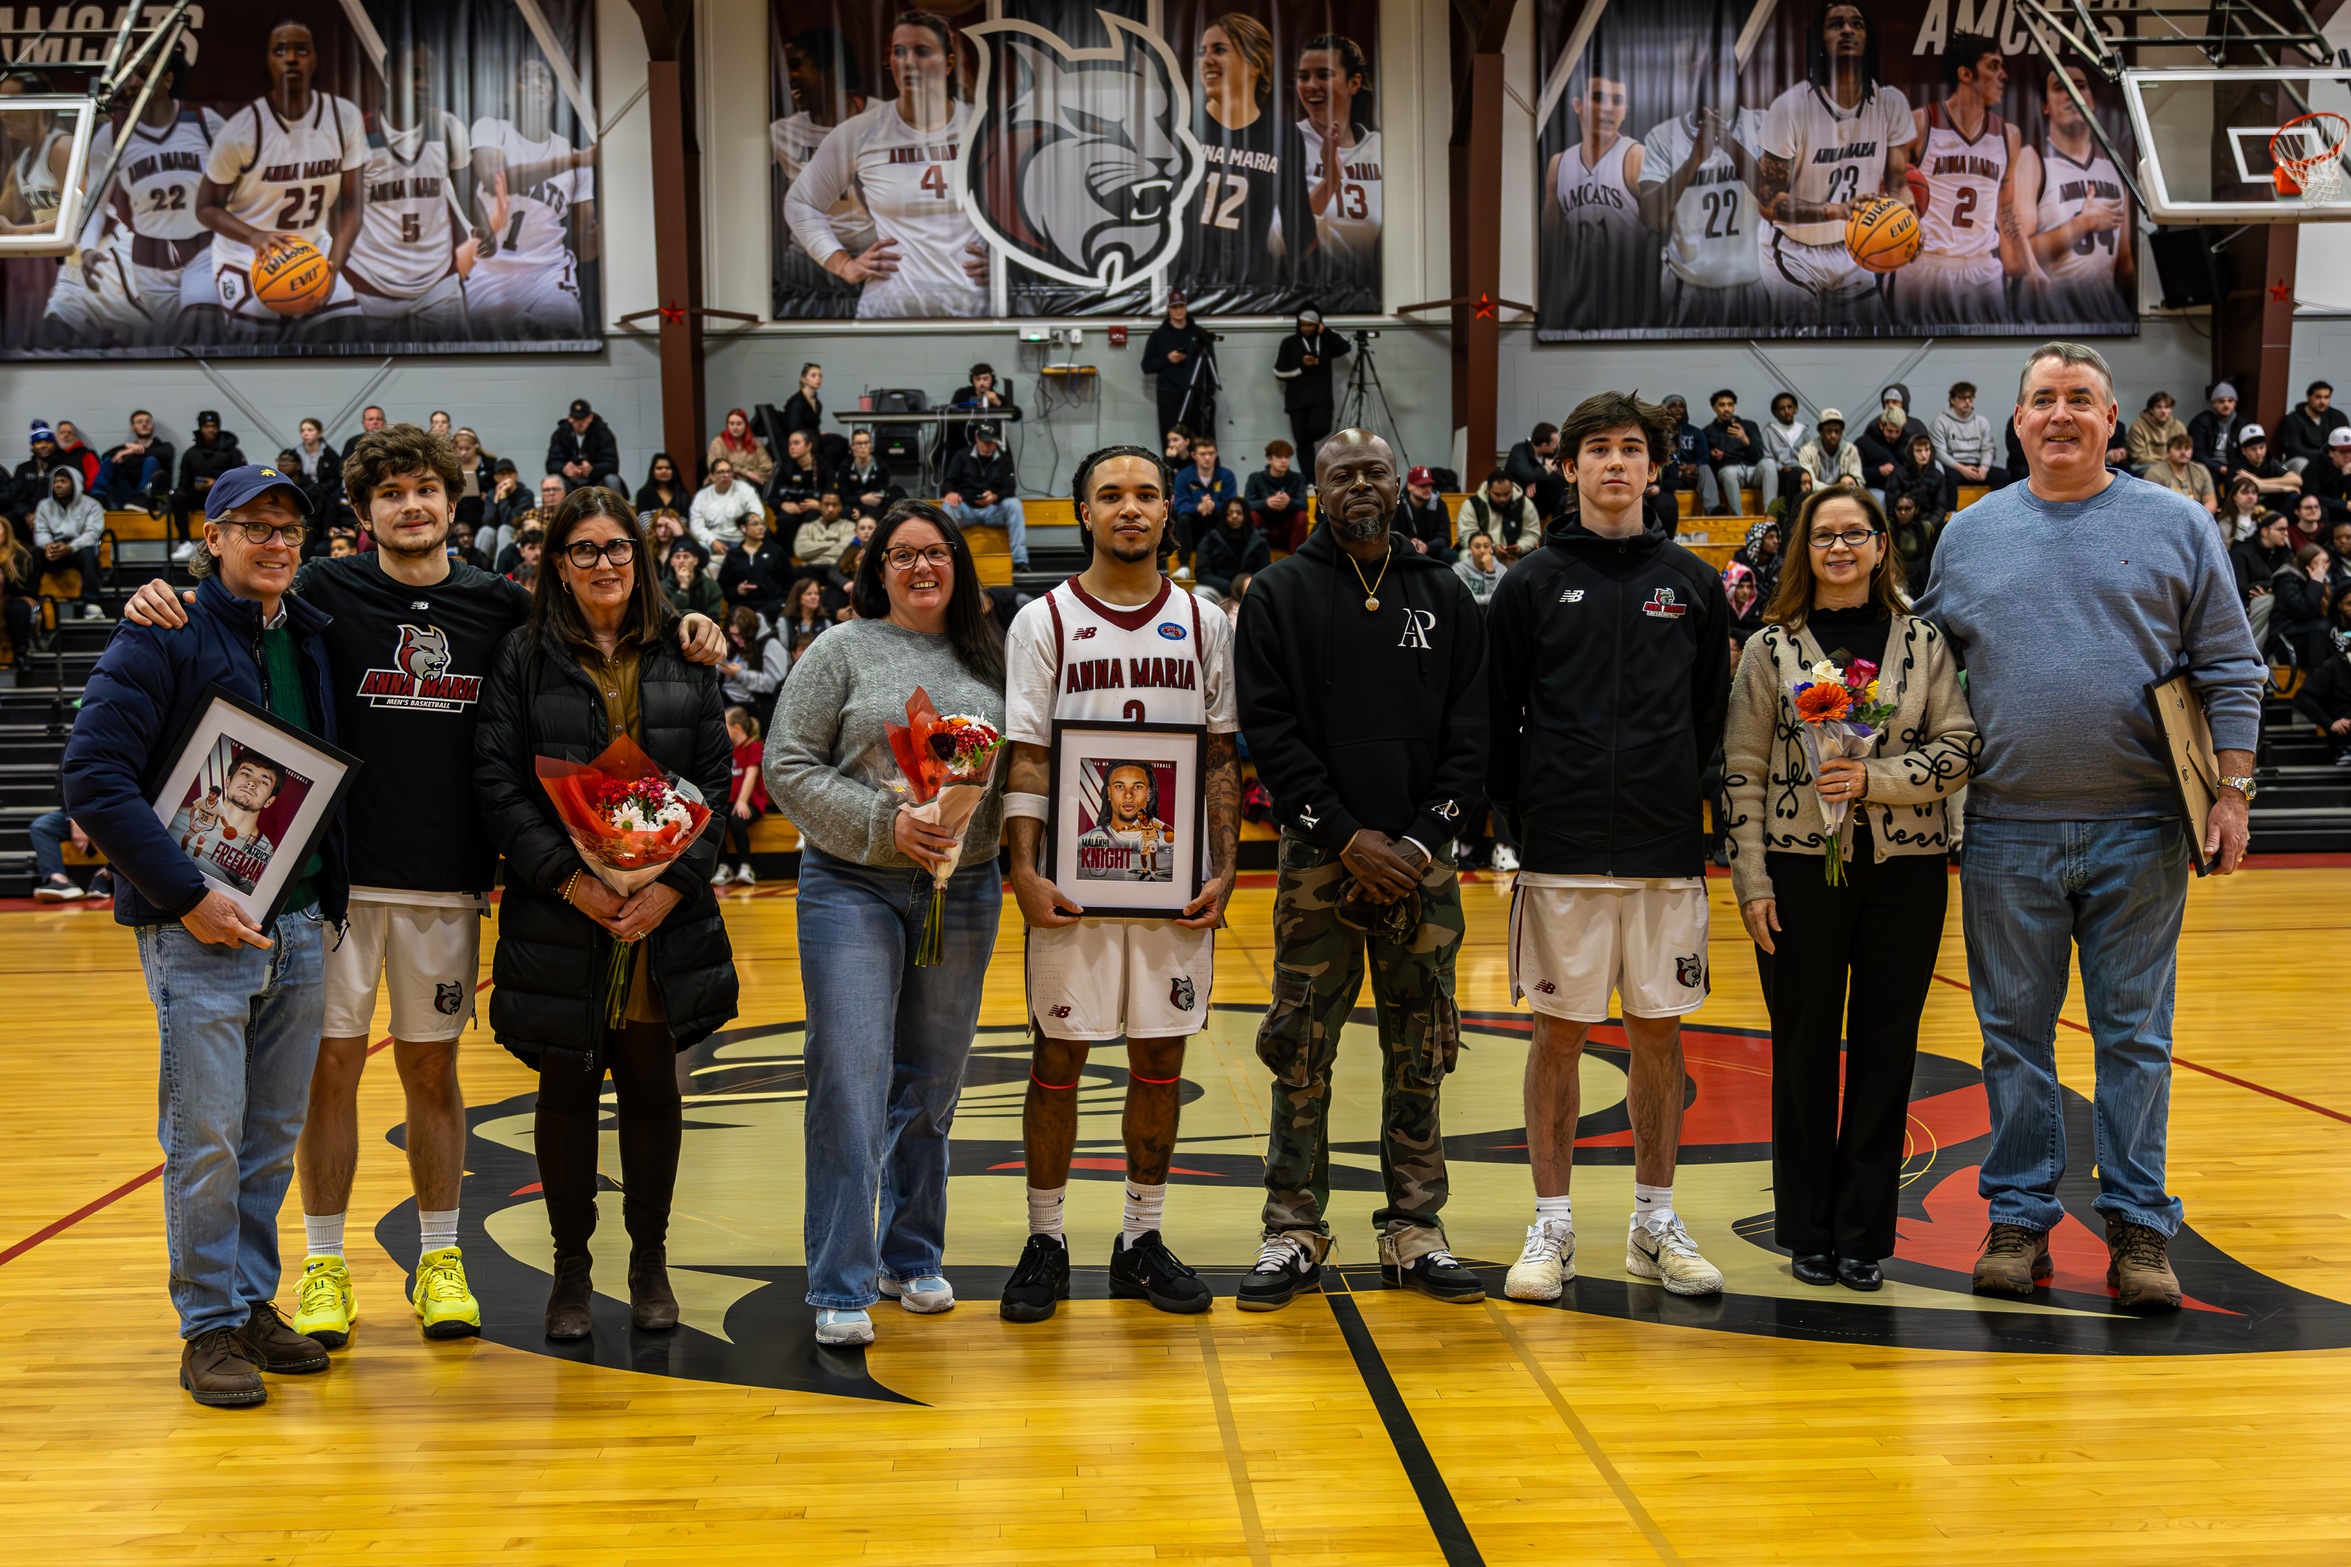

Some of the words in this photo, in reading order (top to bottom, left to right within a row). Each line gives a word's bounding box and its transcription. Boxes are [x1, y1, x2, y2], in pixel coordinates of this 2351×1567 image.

[1229, 148, 1279, 174] MARIA
[150, 184, 187, 212] 22
[920, 164, 949, 199] 4
[1828, 165, 1859, 203] 23
[276, 184, 326, 230] 23
[1201, 171, 1249, 229] 12
[1334, 183, 1369, 220] 13
[1702, 189, 1740, 239] 22
[1861, 199, 1900, 227] Wilson
[1952, 187, 1978, 229] 2
[402, 213, 420, 243] 5
[502, 210, 525, 251] 1
[263, 244, 312, 275] Wilson
[361, 672, 414, 696] ANNA
[419, 676, 481, 701] MARIA
[1066, 658, 1125, 694] ANNA
[1129, 657, 1196, 691] MARIA
[386, 698, 408, 706] MEN'S
[410, 700, 450, 709] BASKETBALL
[243, 844, 272, 863] PATRICK
[1081, 838, 1109, 848] MALAKHI
[1081, 847, 1132, 869] KNIGHT
[210, 840, 268, 883] FREEMAN
